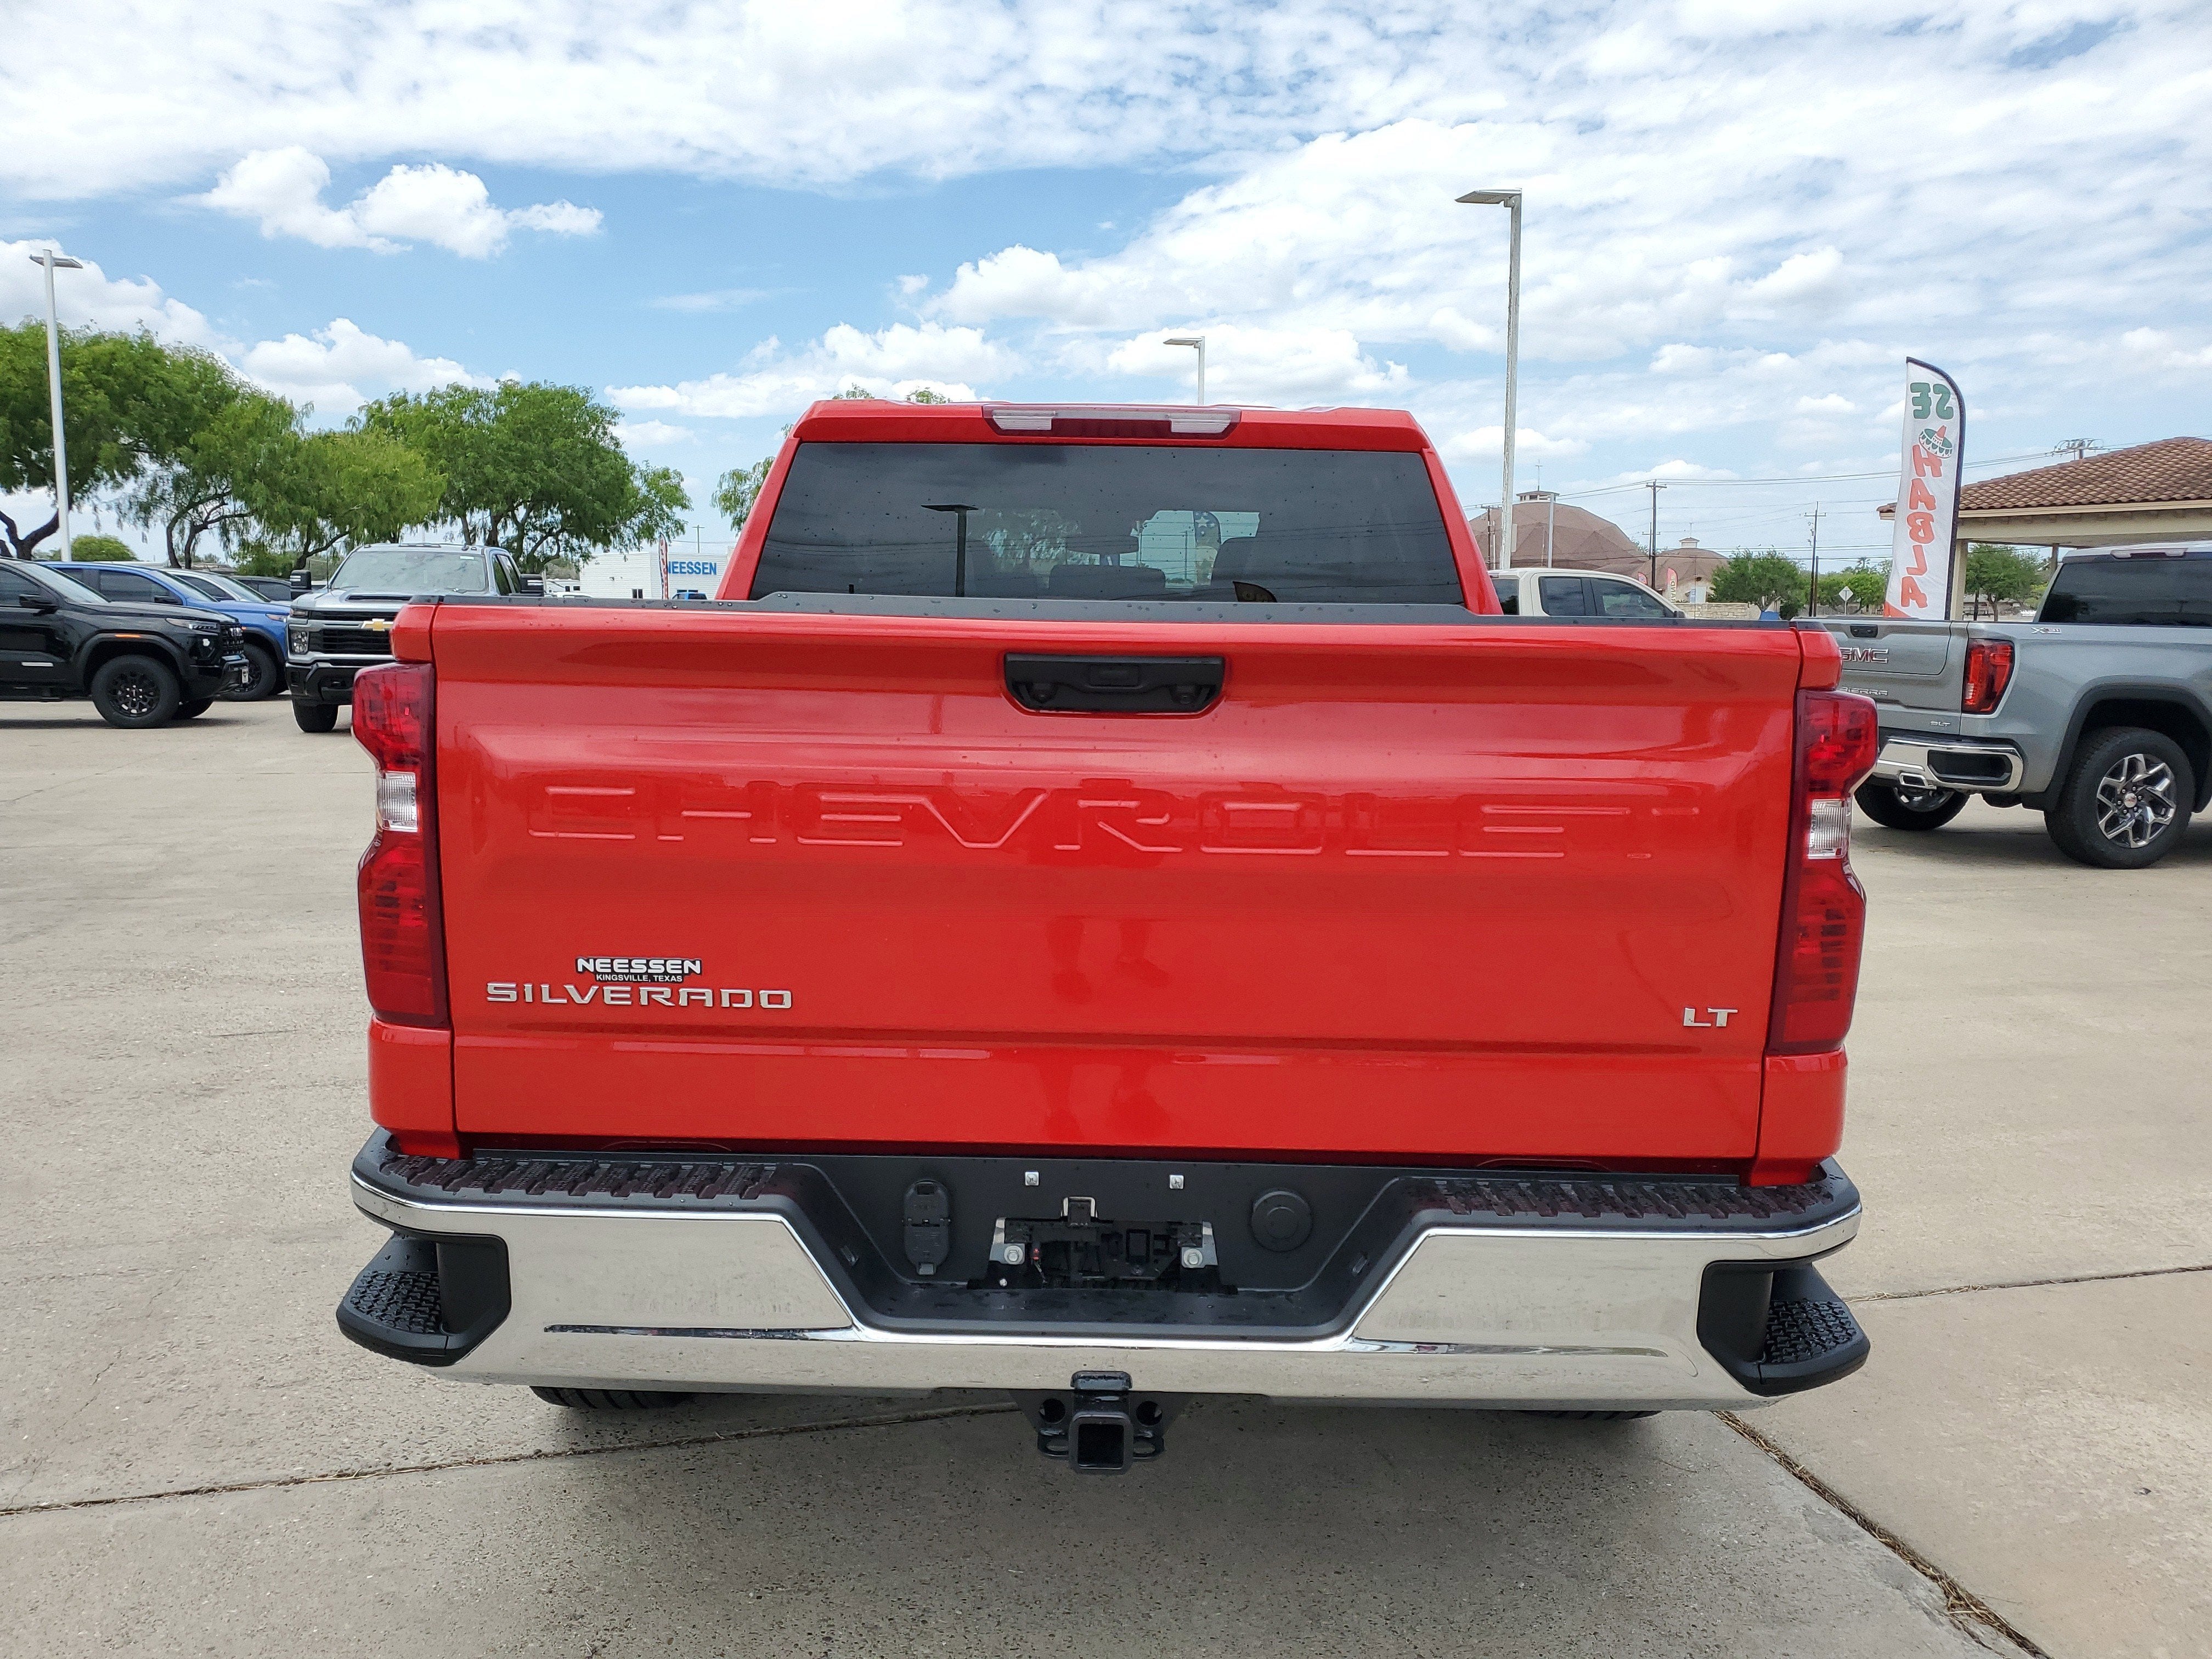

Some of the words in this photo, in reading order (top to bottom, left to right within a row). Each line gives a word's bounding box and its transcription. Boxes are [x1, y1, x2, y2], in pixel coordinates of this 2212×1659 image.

[577, 958, 702, 974] NEESSEN
[596, 974, 651, 983] KINGSVILLE,
[652, 974, 682, 983] TEXAS
[486, 982, 793, 1009] SILVERADO
[1683, 1007, 1738, 1027] LT
